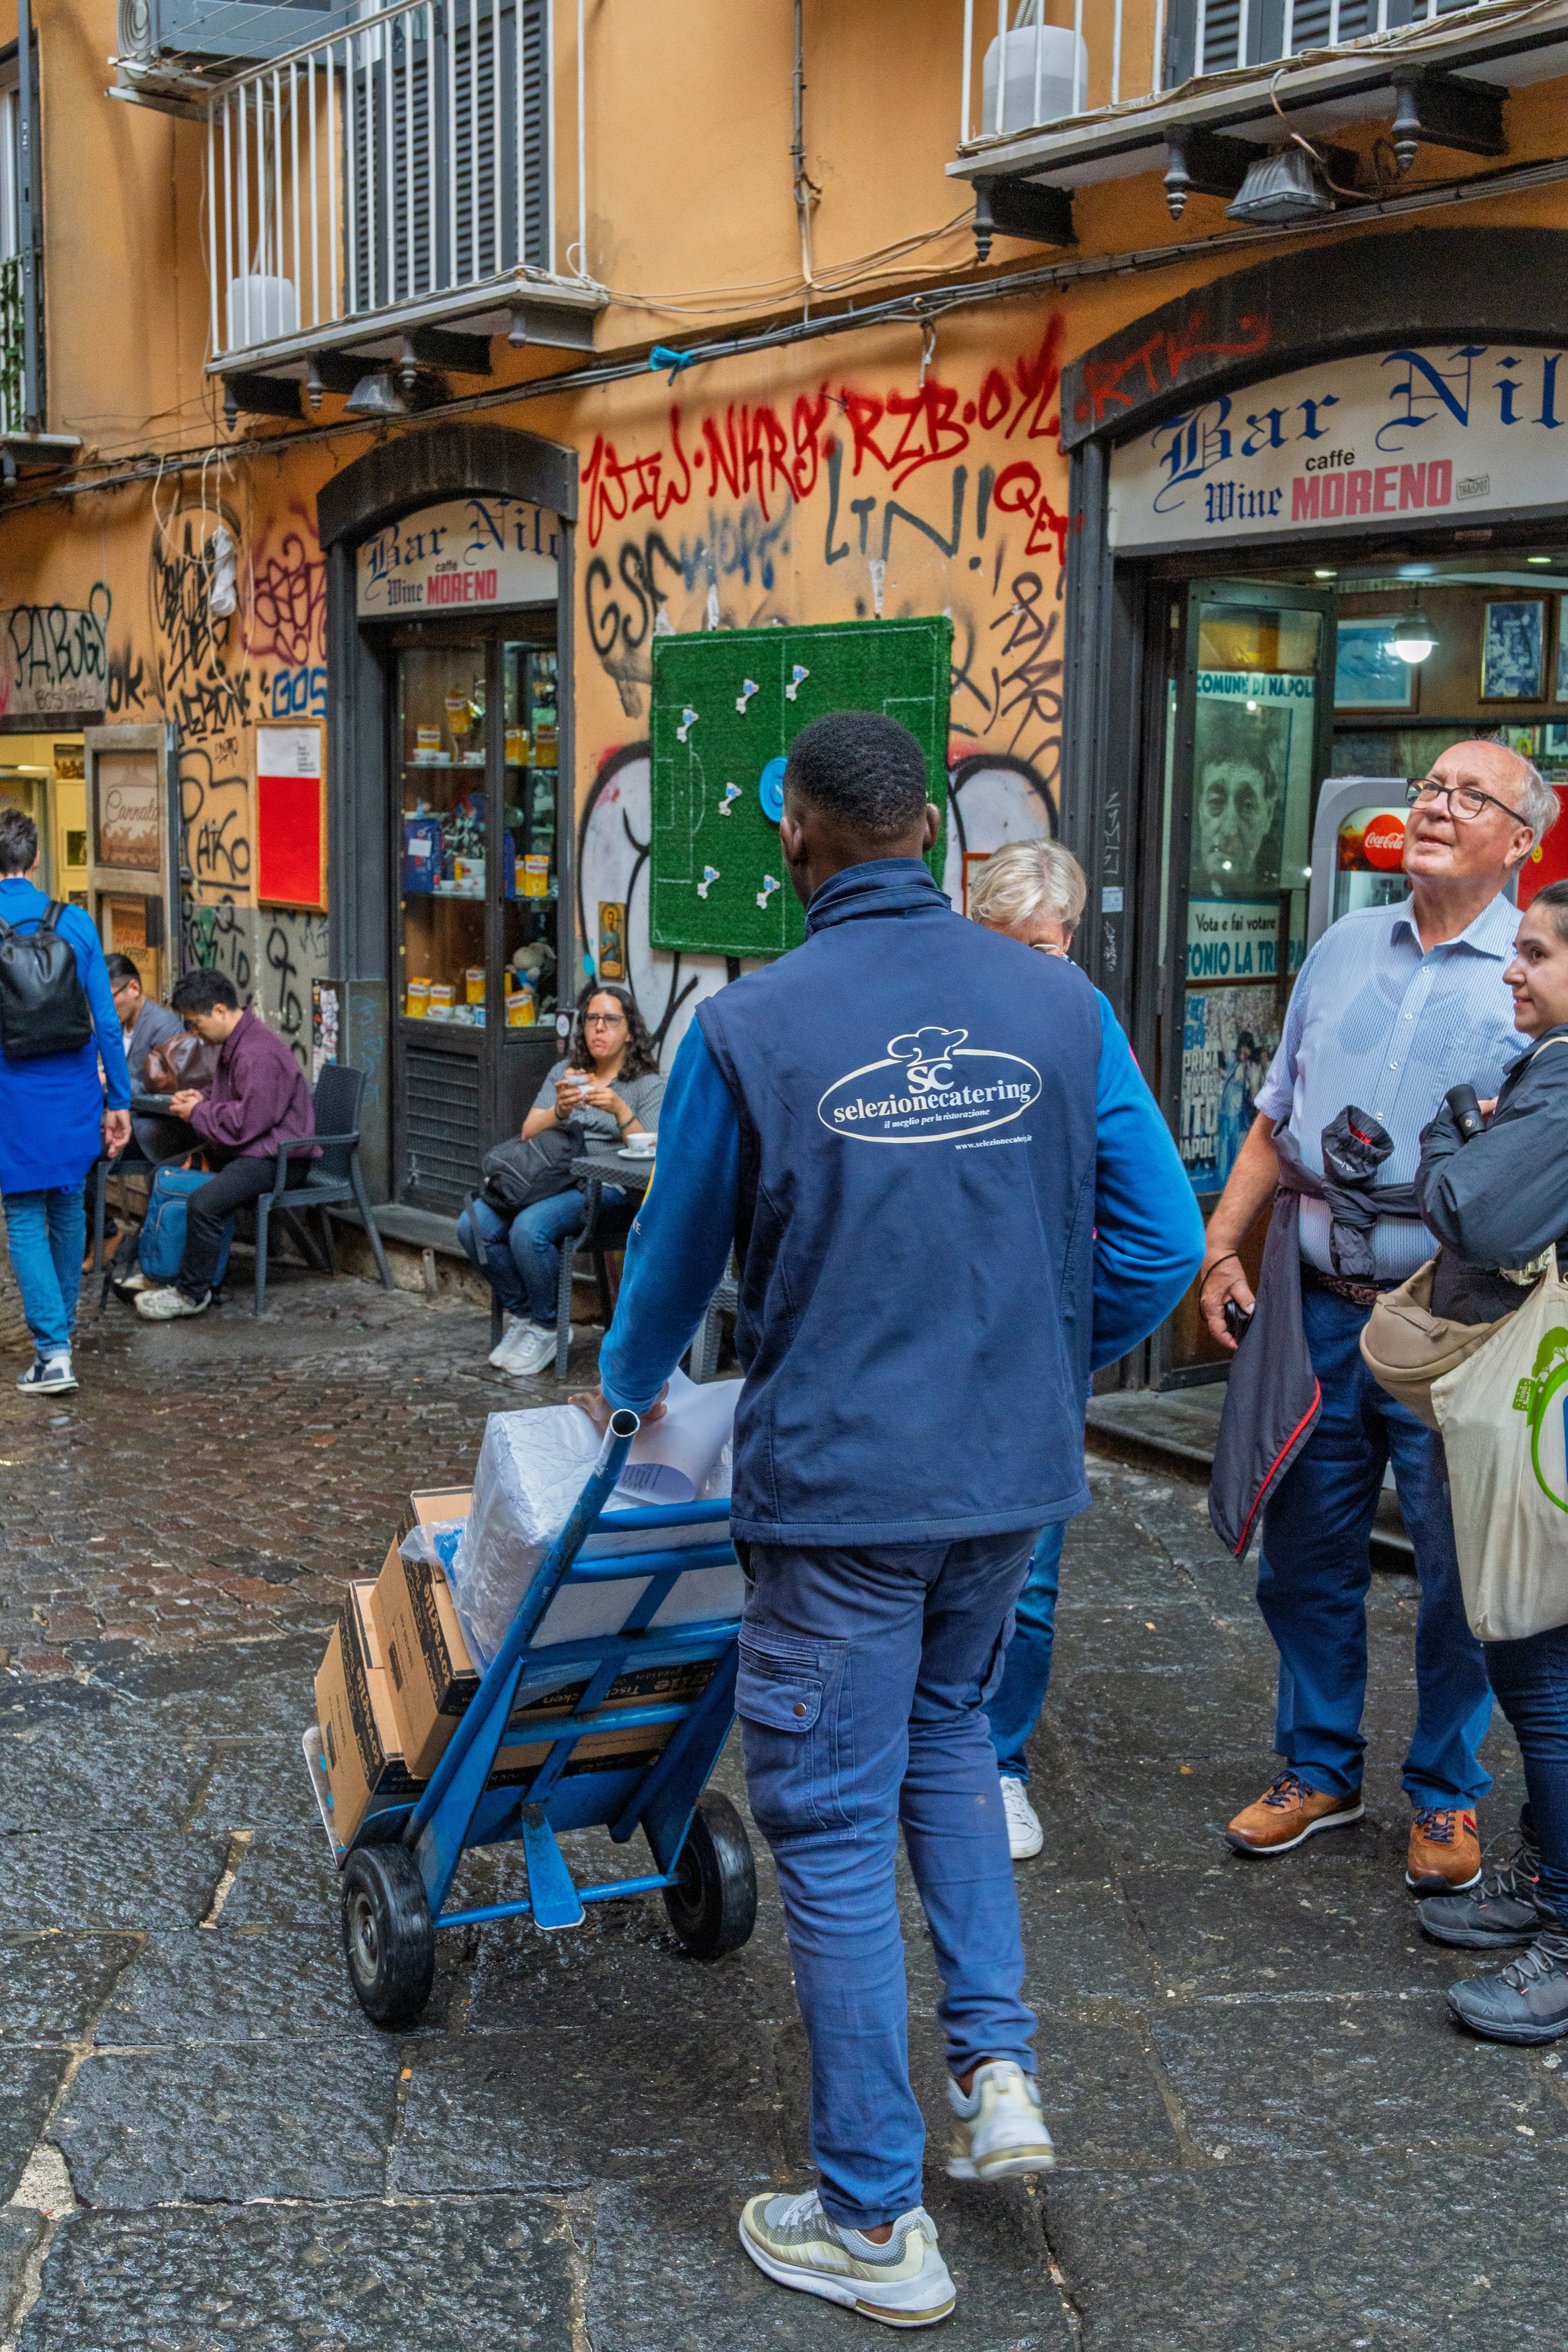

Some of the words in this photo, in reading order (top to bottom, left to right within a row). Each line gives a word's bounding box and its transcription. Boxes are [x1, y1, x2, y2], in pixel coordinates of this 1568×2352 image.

[1153, 393, 1340, 513] Bar
[1205, 481, 1282, 524] Wine
[1291, 459, 1453, 522] MORENO
[365, 521, 448, 600] Bar
[387, 579, 423, 606] Wine
[427, 569, 497, 605] MORENO
[1365, 832, 1404, 850] Coca-Cola
[1196, 914, 1219, 932] Vota
[1222, 921, 1227, 930] e
[1231, 913, 1244, 931] fai
[1246, 917, 1276, 930] votare
[1235, 941, 1253, 974] LA
[907, 1063, 954, 1093] SC
[833, 1080, 1031, 1123] selezionecatering
[884, 1120, 890, 1129] il
[892, 1116, 919, 1129] meglio
[921, 1114, 934, 1125] per
[935, 1113, 942, 1122] la
[943, 1108, 990, 1121] ristorazione
[1519, 1385, 1528, 1402] EURO
